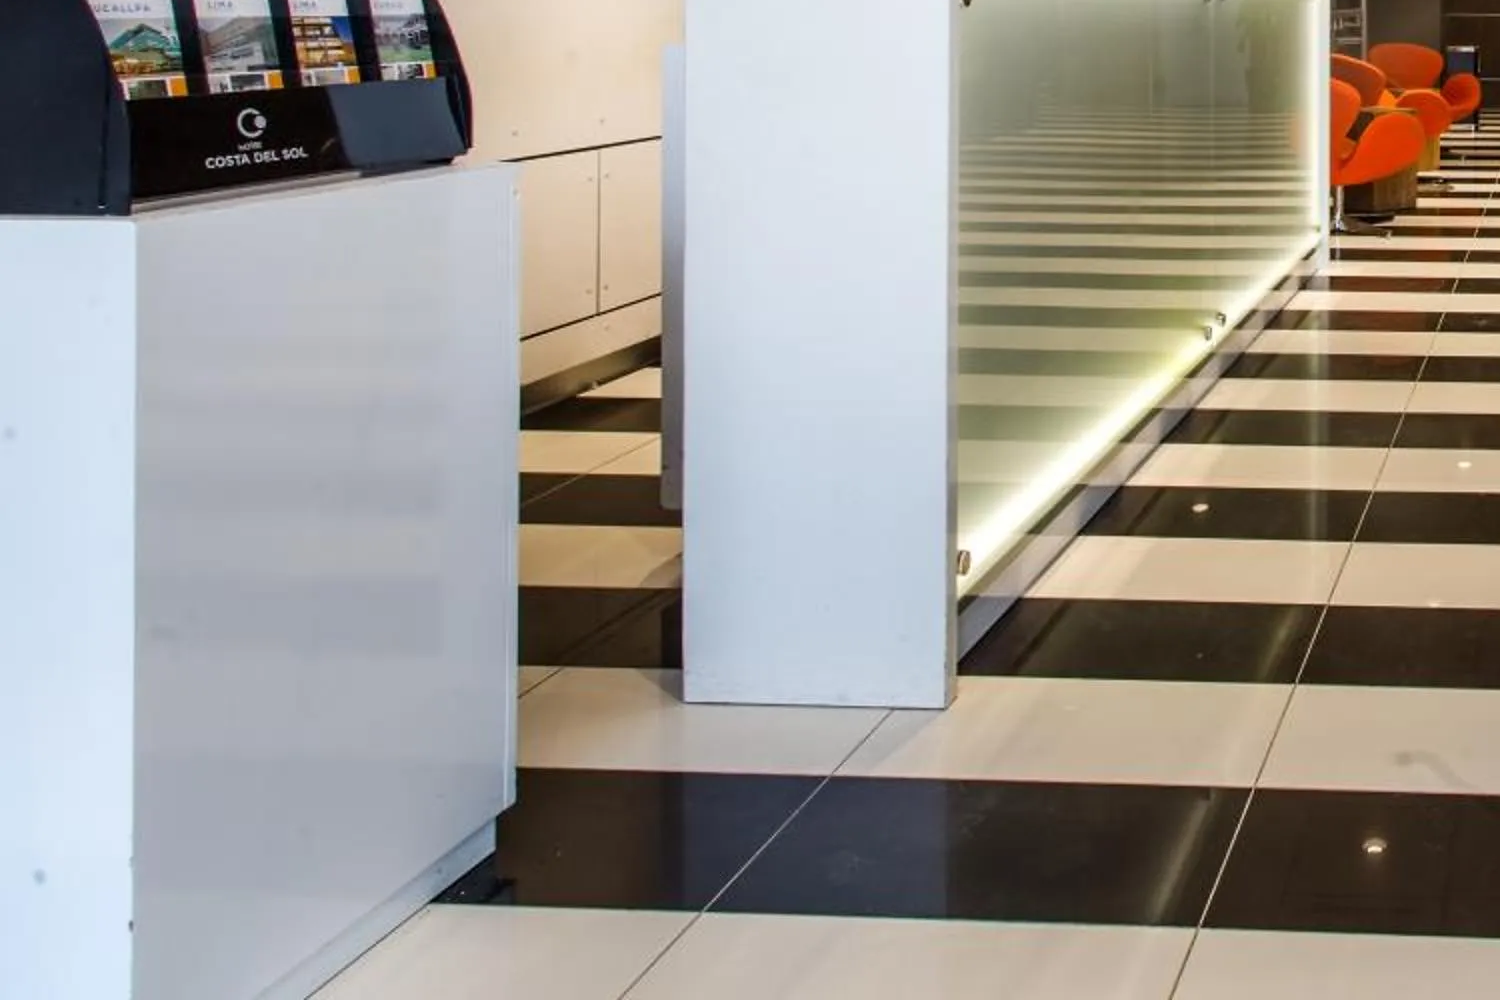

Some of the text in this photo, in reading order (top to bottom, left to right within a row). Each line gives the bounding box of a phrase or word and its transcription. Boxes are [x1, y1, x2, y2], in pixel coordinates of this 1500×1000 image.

[94, 3, 152, 13] UCALLPA
[207, 0, 234, 10] LIMA
[205, 146, 309, 169] COSTA DEL SOL
